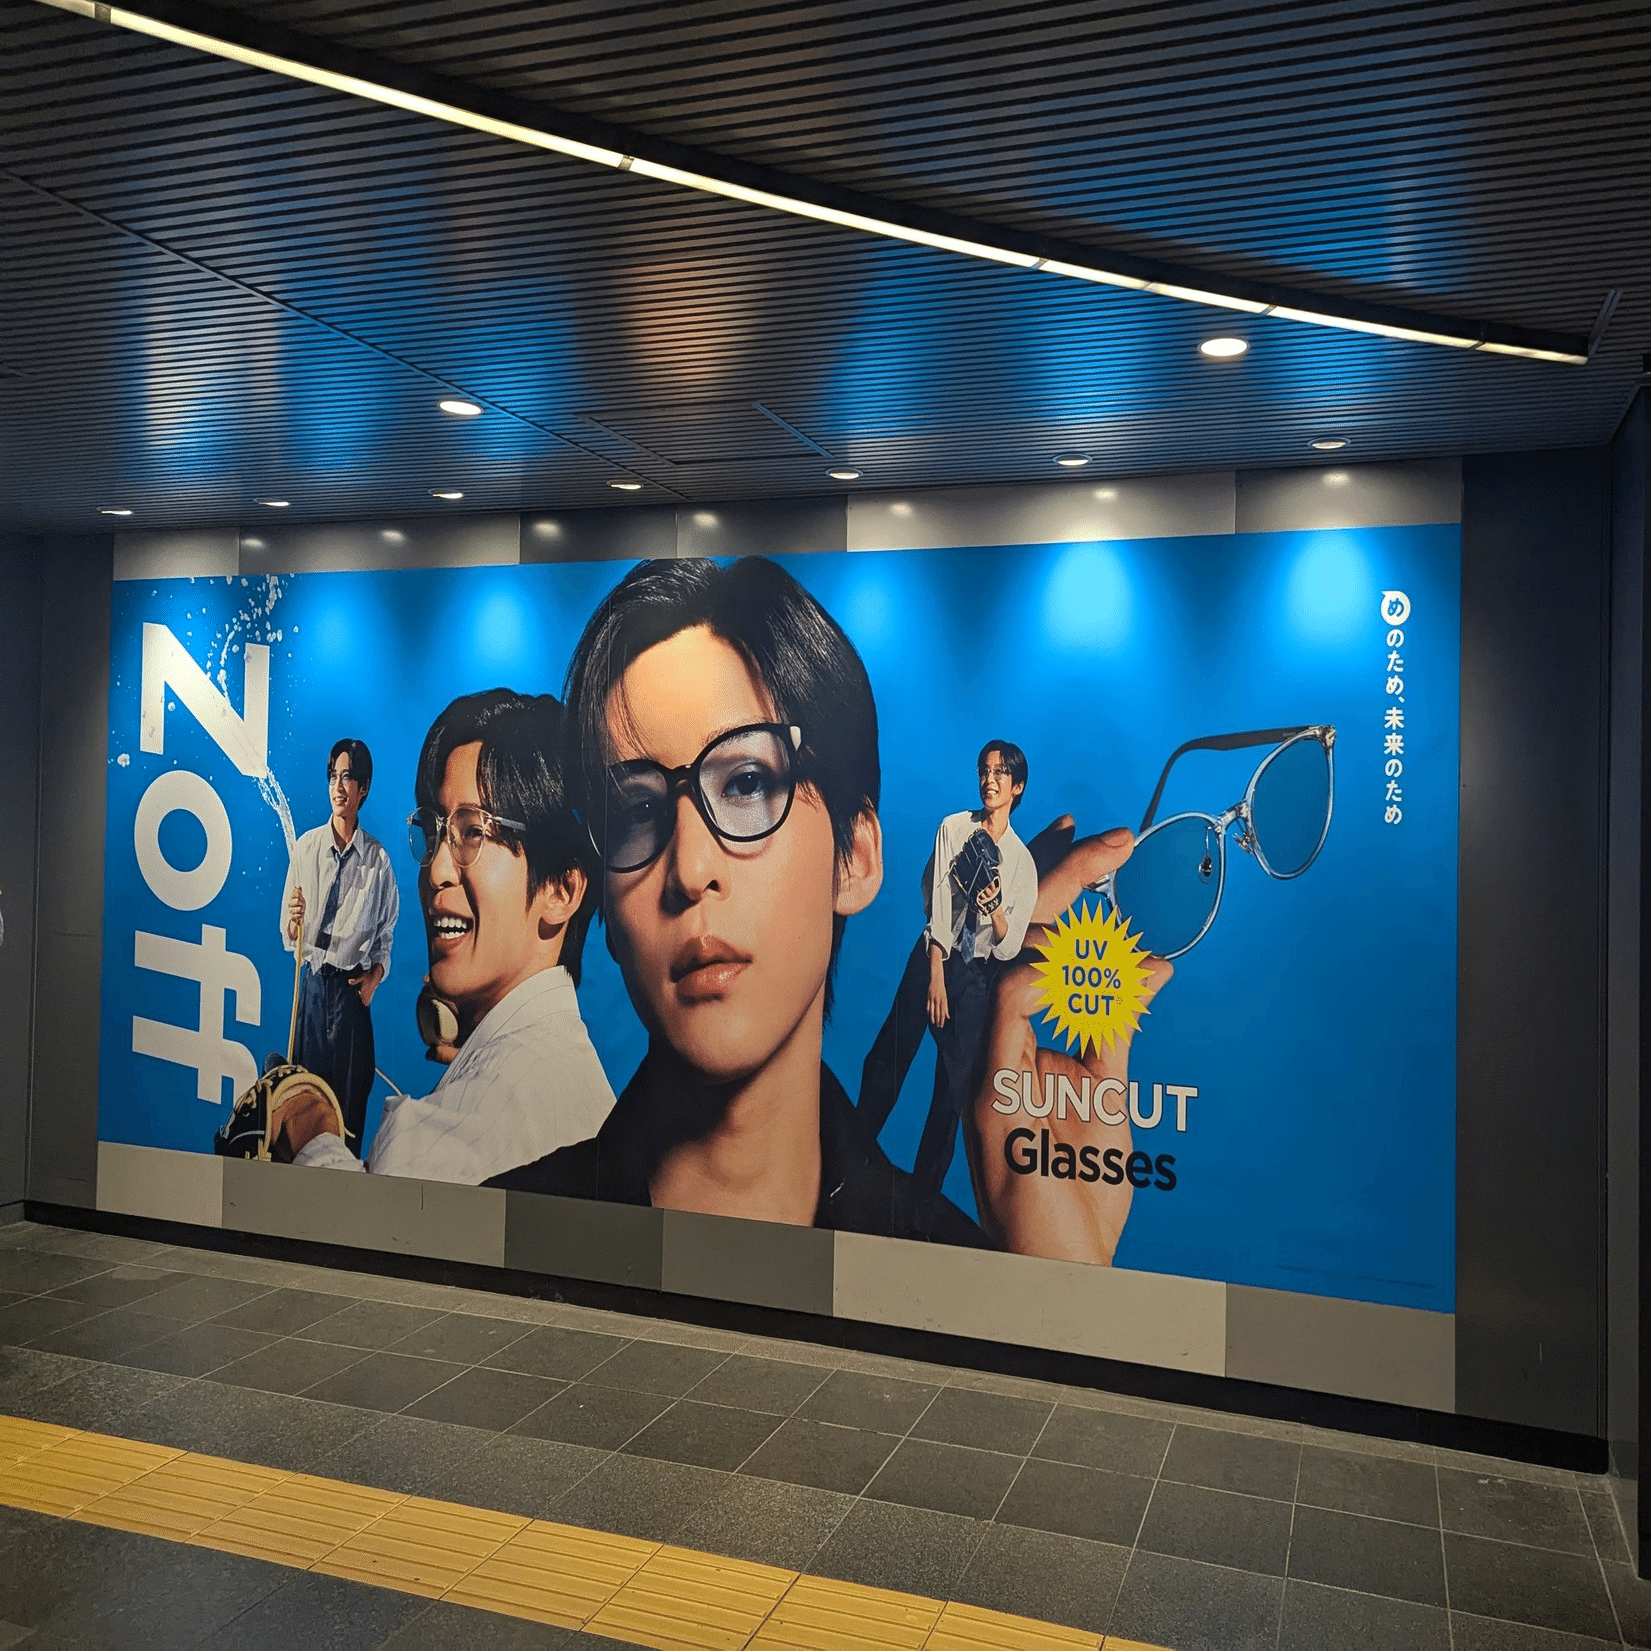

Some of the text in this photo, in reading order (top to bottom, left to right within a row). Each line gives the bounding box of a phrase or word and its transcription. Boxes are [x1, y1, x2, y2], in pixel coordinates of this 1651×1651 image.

[1382, 593, 1408, 825] めのため、未来のため
[132, 622, 270, 1104] Zoff
[1062, 965, 1121, 989] 100%
[1075, 939, 1108, 961] UV
[1068, 993, 1115, 1016] CUT
[992, 1068, 1199, 1132] SUNCUT
[1004, 1127, 1177, 1191] Glasses
